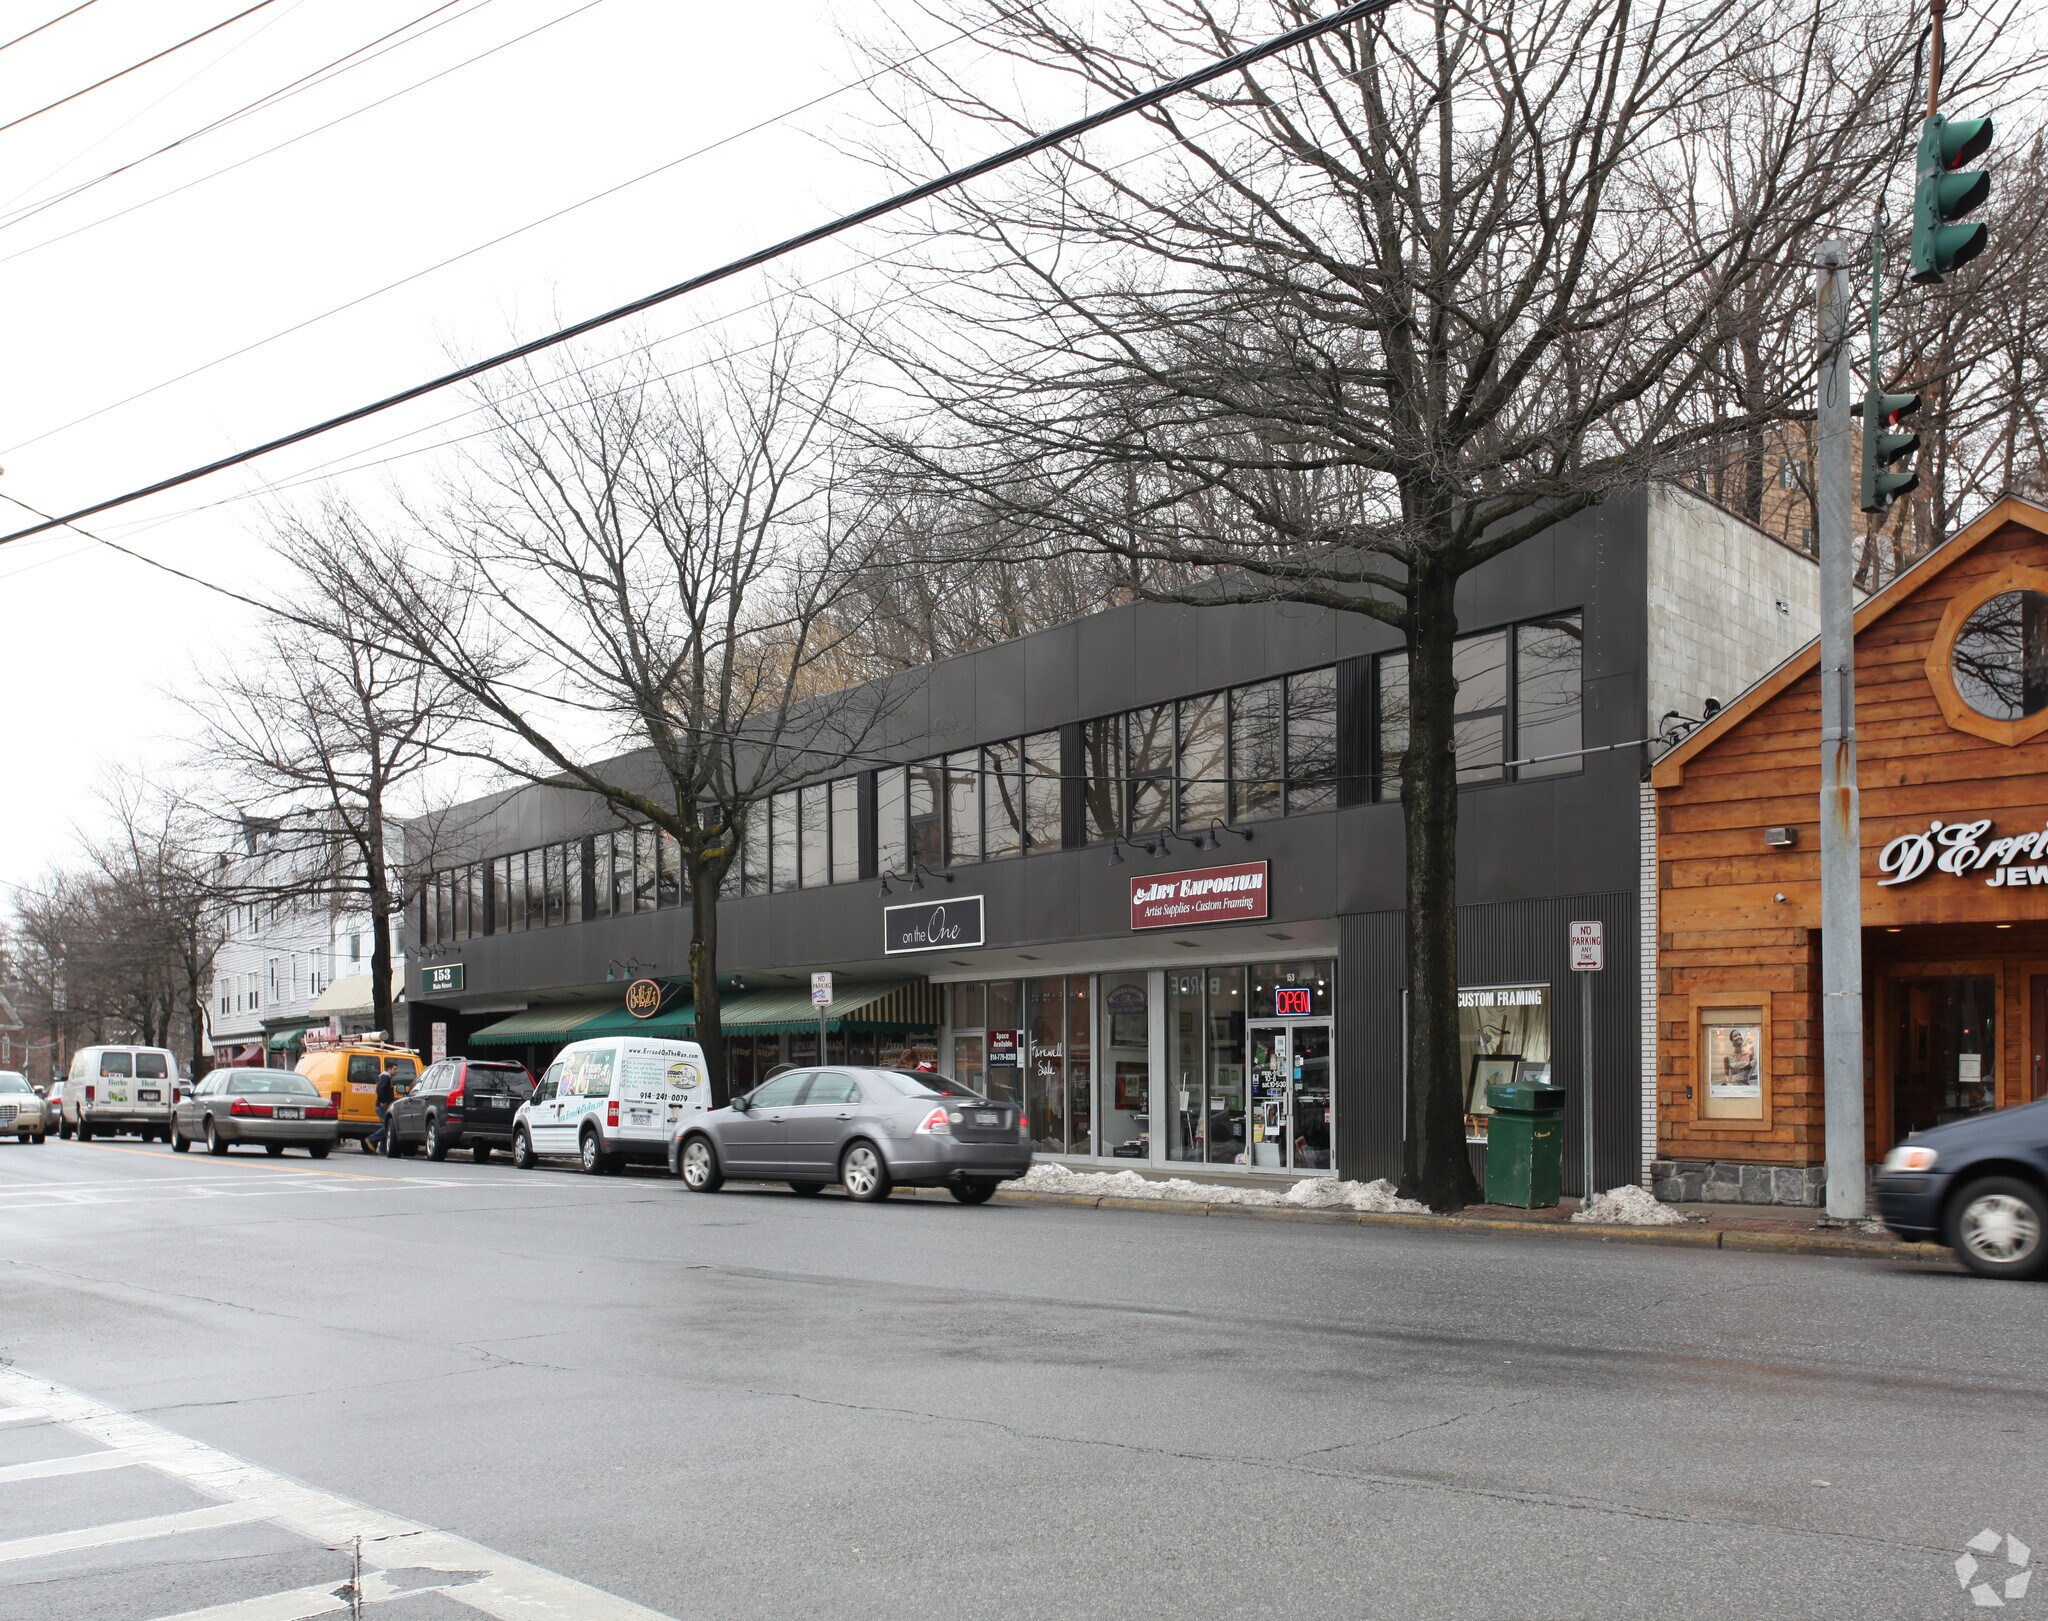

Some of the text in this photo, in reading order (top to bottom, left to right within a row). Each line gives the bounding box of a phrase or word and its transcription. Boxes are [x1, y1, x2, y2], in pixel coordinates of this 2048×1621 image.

[1133, 873, 1263, 905] ART EMPORIUM
[1144, 896, 1254, 917] Artist Supplies Custom Framing
[903, 906, 961, 943] on the One
[1580, 926, 1592, 935] NO
[1572, 936, 1601, 946] PARKING
[433, 968, 451, 982] 153
[1286, 973, 1295, 982] 153
[812, 982, 832, 990] PARKING
[1277, 990, 1309, 1013] OPEN
[1497, 990, 1542, 1006] FRAMING
[995, 1032, 1010, 1041] Space
[993, 1040, 1013, 1048] Available
[628, 1047, 699, 1059] www.ErrandOnTheRun.com
[1037, 1060, 1056, 1076] Sale
[639, 1091, 688, 1102] 914-241-0079
